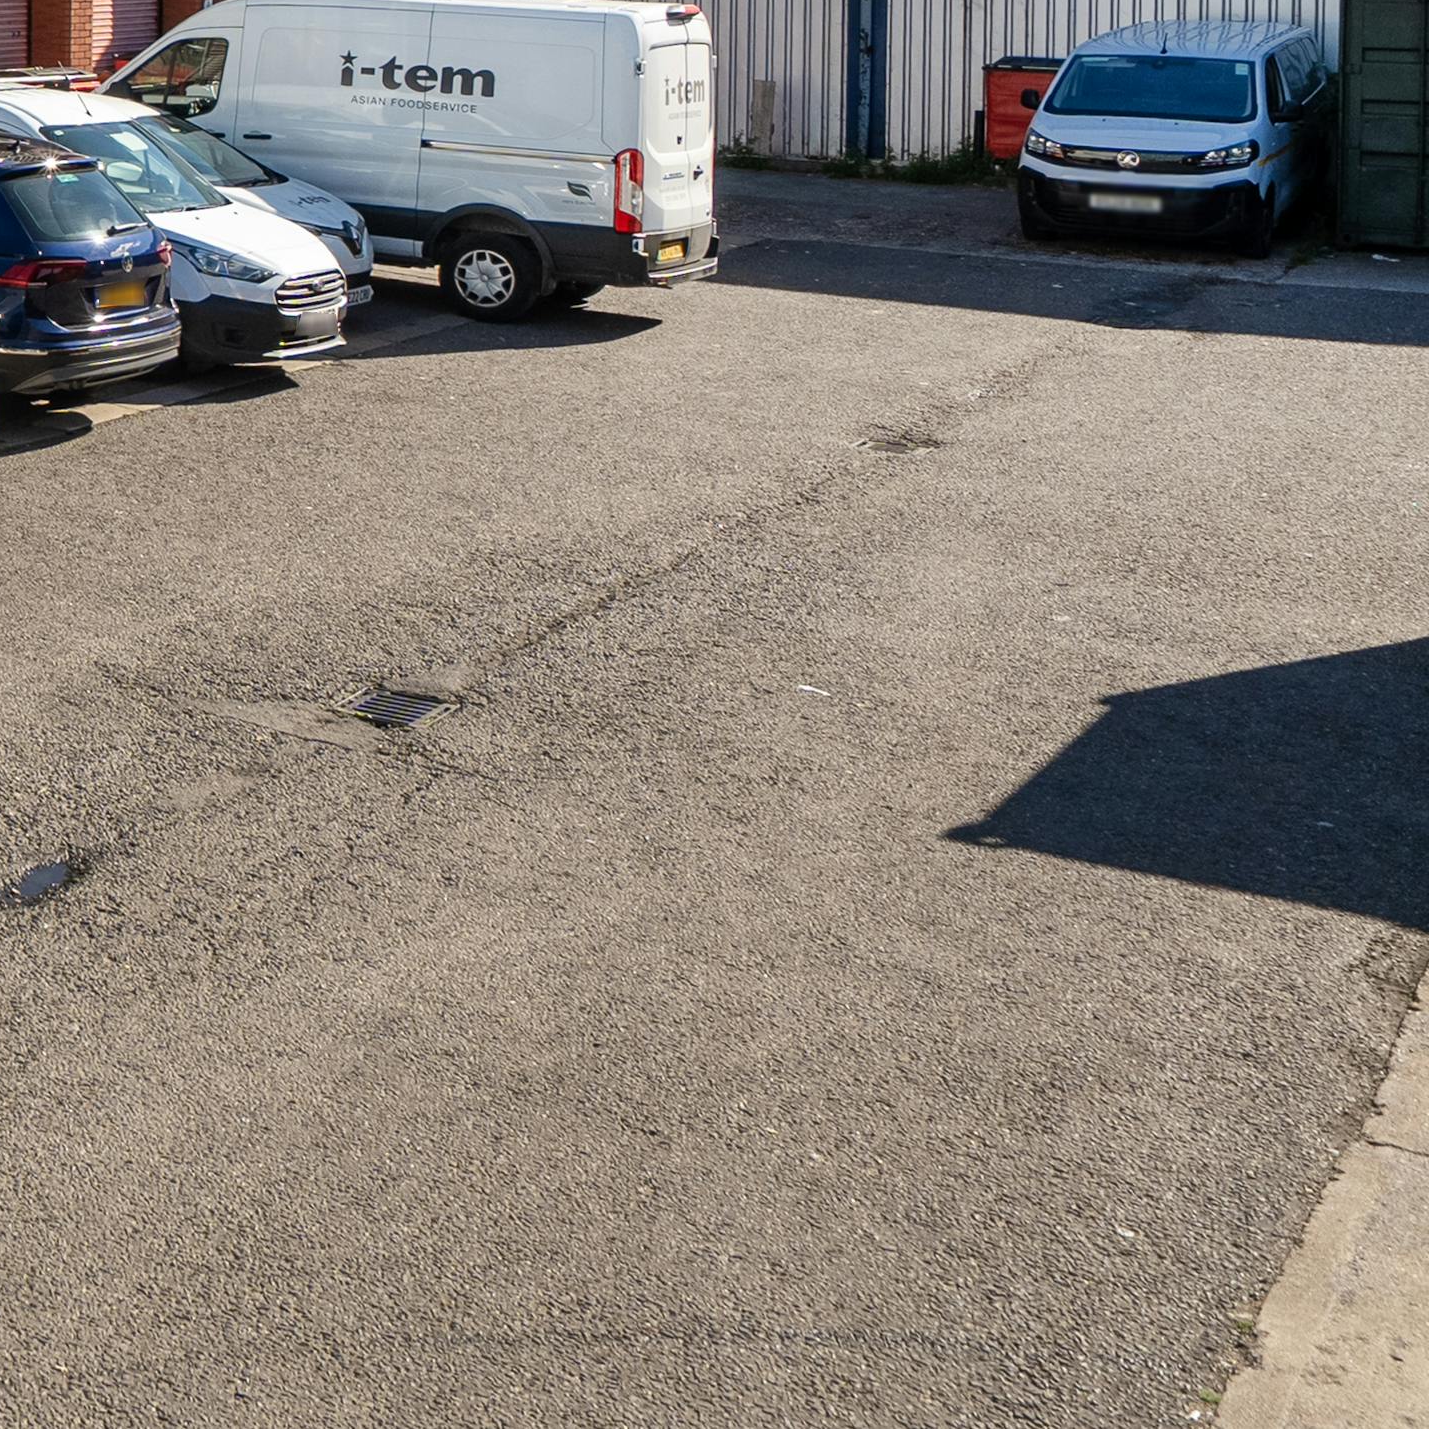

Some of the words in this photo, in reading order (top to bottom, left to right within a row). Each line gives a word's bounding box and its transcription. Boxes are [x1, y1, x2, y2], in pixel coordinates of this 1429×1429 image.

[340, 50, 495, 98] i-tem
[351, 95, 386, 106] ASIAN
[390, 97, 478, 114] FOODSERVICE
[664, 77, 705, 106] i-tem
